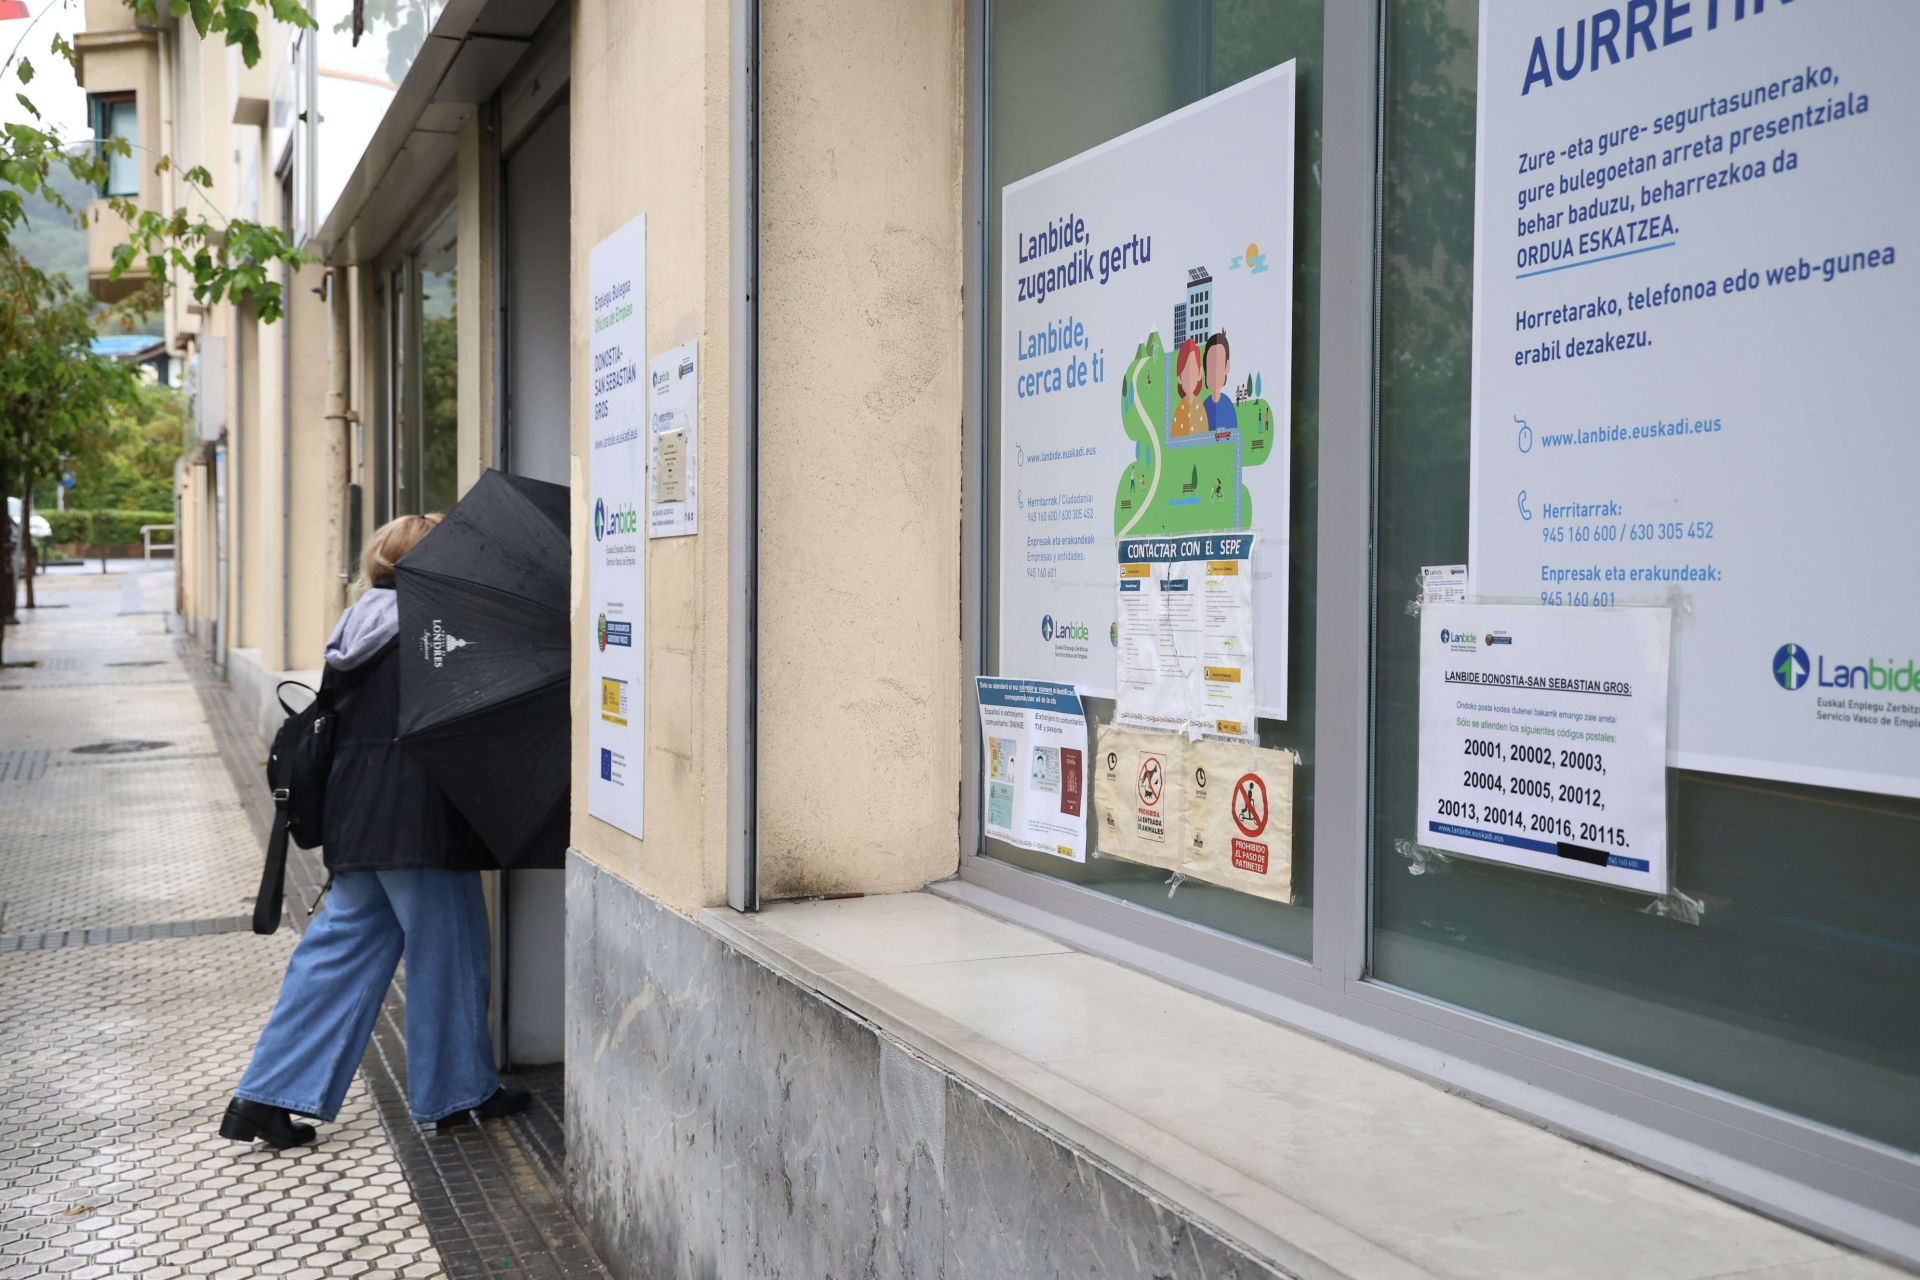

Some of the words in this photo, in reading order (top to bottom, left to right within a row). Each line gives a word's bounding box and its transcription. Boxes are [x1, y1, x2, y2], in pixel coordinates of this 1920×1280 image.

[1521, 0, 1794, 96] AURRE
[1518, 151, 1555, 175] Zure
[1560, 137, 1593, 160] -eta
[1598, 127, 1647, 156] gure-
[1653, 66, 1840, 135] segurtasunerako,
[1518, 183, 1554, 210] gure
[1560, 153, 1656, 195] bulegoetan
[1662, 135, 1723, 167] arreta
[1730, 92, 1869, 154] presentziala
[1518, 210, 1564, 237] behar
[1568, 194, 1635, 224] baduzu,
[1641, 158, 1765, 207] beharrezkoa
[1772, 150, 1798, 174] da
[1019, 213, 1090, 264] Lanbide,
[1517, 237, 1574, 268] ORDUA
[1579, 214, 1679, 255] ESKATZEA.
[1018, 248, 1094, 304] zugandik
[1099, 234, 1151, 285] gertu
[1516, 297, 1623, 331] Horretarako,
[1627, 281, 1717, 312] telefonoa
[1723, 269, 1759, 294] edo
[1766, 247, 1895, 286] web-gunea
[1018, 316, 1088, 361] Lanbide,
[1515, 340, 1561, 366] erabil
[1565, 330, 1652, 359] dezakezu.
[595, 344, 623, 372] DONOSTIA-
[595, 377, 605, 396] SAN
[606, 359, 636, 392] SEBASTIÁN
[1018, 366, 1061, 398] cerca
[1066, 355, 1087, 388] de
[1092, 348, 1104, 383] ti
[595, 400, 608, 420] GROS
[1542, 418, 1722, 448] www.lanbide.euskadi.eus
[1027, 447, 1096, 463] www.lanbide.euskadi.eus
[1027, 495, 1057, 507] Herritarrak
[1543, 500, 1622, 519] Herritarrak:
[606, 502, 637, 535] Lanbide
[1027, 511, 1036, 522] 945
[1038, 511, 1046, 521] 160
[1062, 509, 1071, 520] 630
[1083, 508, 1094, 519] 452
[1027, 535, 1051, 547] Enpresak
[1052, 536, 1060, 546] eta
[1543, 527, 1564, 543] 945
[1569, 526, 1589, 542] 160
[1594, 525, 1616, 541] 600
[1620, 524, 1627, 542] /
[1630, 524, 1654, 540] 630
[1658, 523, 1683, 539] 305
[1687, 522, 1714, 539] 452
[1027, 551, 1052, 564] Empresas
[1128, 544, 1177, 558] CONTACTAR
[1180, 541, 1200, 556] CON
[1205, 540, 1214, 555] EL
[1220, 539, 1241, 555] SEPE
[1027, 568, 1036, 577] 945
[1037, 568, 1046, 577] 160
[1541, 565, 1601, 584] Enpresak
[1605, 566, 1626, 581] eta
[1630, 564, 1722, 581] erakundeak:
[1541, 591, 1562, 607] 945
[1567, 591, 1589, 607] 160
[1593, 592, 1615, 607] 601
[1055, 620, 1089, 641] Lanbide
[1450, 632, 1477, 643] Lanbide
[432, 619, 444, 668] LONDRES
[1445, 671, 1480, 683] LANBIDE
[1482, 673, 1546, 688] DONOSTIA-SAN
[1549, 677, 1601, 692] SEBASTIAN
[1603, 682, 1632, 695] GROS:
[1456, 701, 1477, 711] Ondoko
[1478, 704, 1493, 712] posta
[1494, 704, 1510, 714] kodea
[1511, 707, 1533, 716] dutenei
[1559, 712, 1583, 722] emango
[1817, 697, 1846, 708] Euskal
[1848, 699, 1884, 713] Enplegu
[1817, 711, 1850, 722] Servicio
[1853, 713, 1878, 724] Vasco
[1880, 716, 1892, 726] de
[1472, 720, 1479, 728] se
[1481, 720, 1507, 731] atienden
[1509, 722, 1519, 732] los
[1521, 724, 1555, 736] siguientes
[1586, 732, 1617, 743] postales:
[1464, 738, 1506, 762] 20001,
[1510, 744, 1556, 769] 20002,
[1560, 750, 1606, 776] 20003,
[1463, 770, 1506, 795] 20004,
[1510, 777, 1554, 803] 20005,
[1558, 784, 1605, 811] 20012,
[1142, 816, 1162, 826] ENTRADA
[1142, 825, 1163, 835] ANIMALES
[1437, 798, 1479, 823] 20013,
[1483, 806, 1526, 831] 20014,
[1530, 813, 1575, 840] 20016,
[1580, 822, 1629, 848] 20115.
[1437, 824, 1504, 843] www.lanbide.euskadi.eus
[1235, 840, 1265, 853] PROHIBIDO
[1235, 850, 1241, 858] EL
[1242, 851, 1257, 861] PASO
[1257, 854, 1265, 863] DE
[1235, 859, 1264, 873] PATINETES
